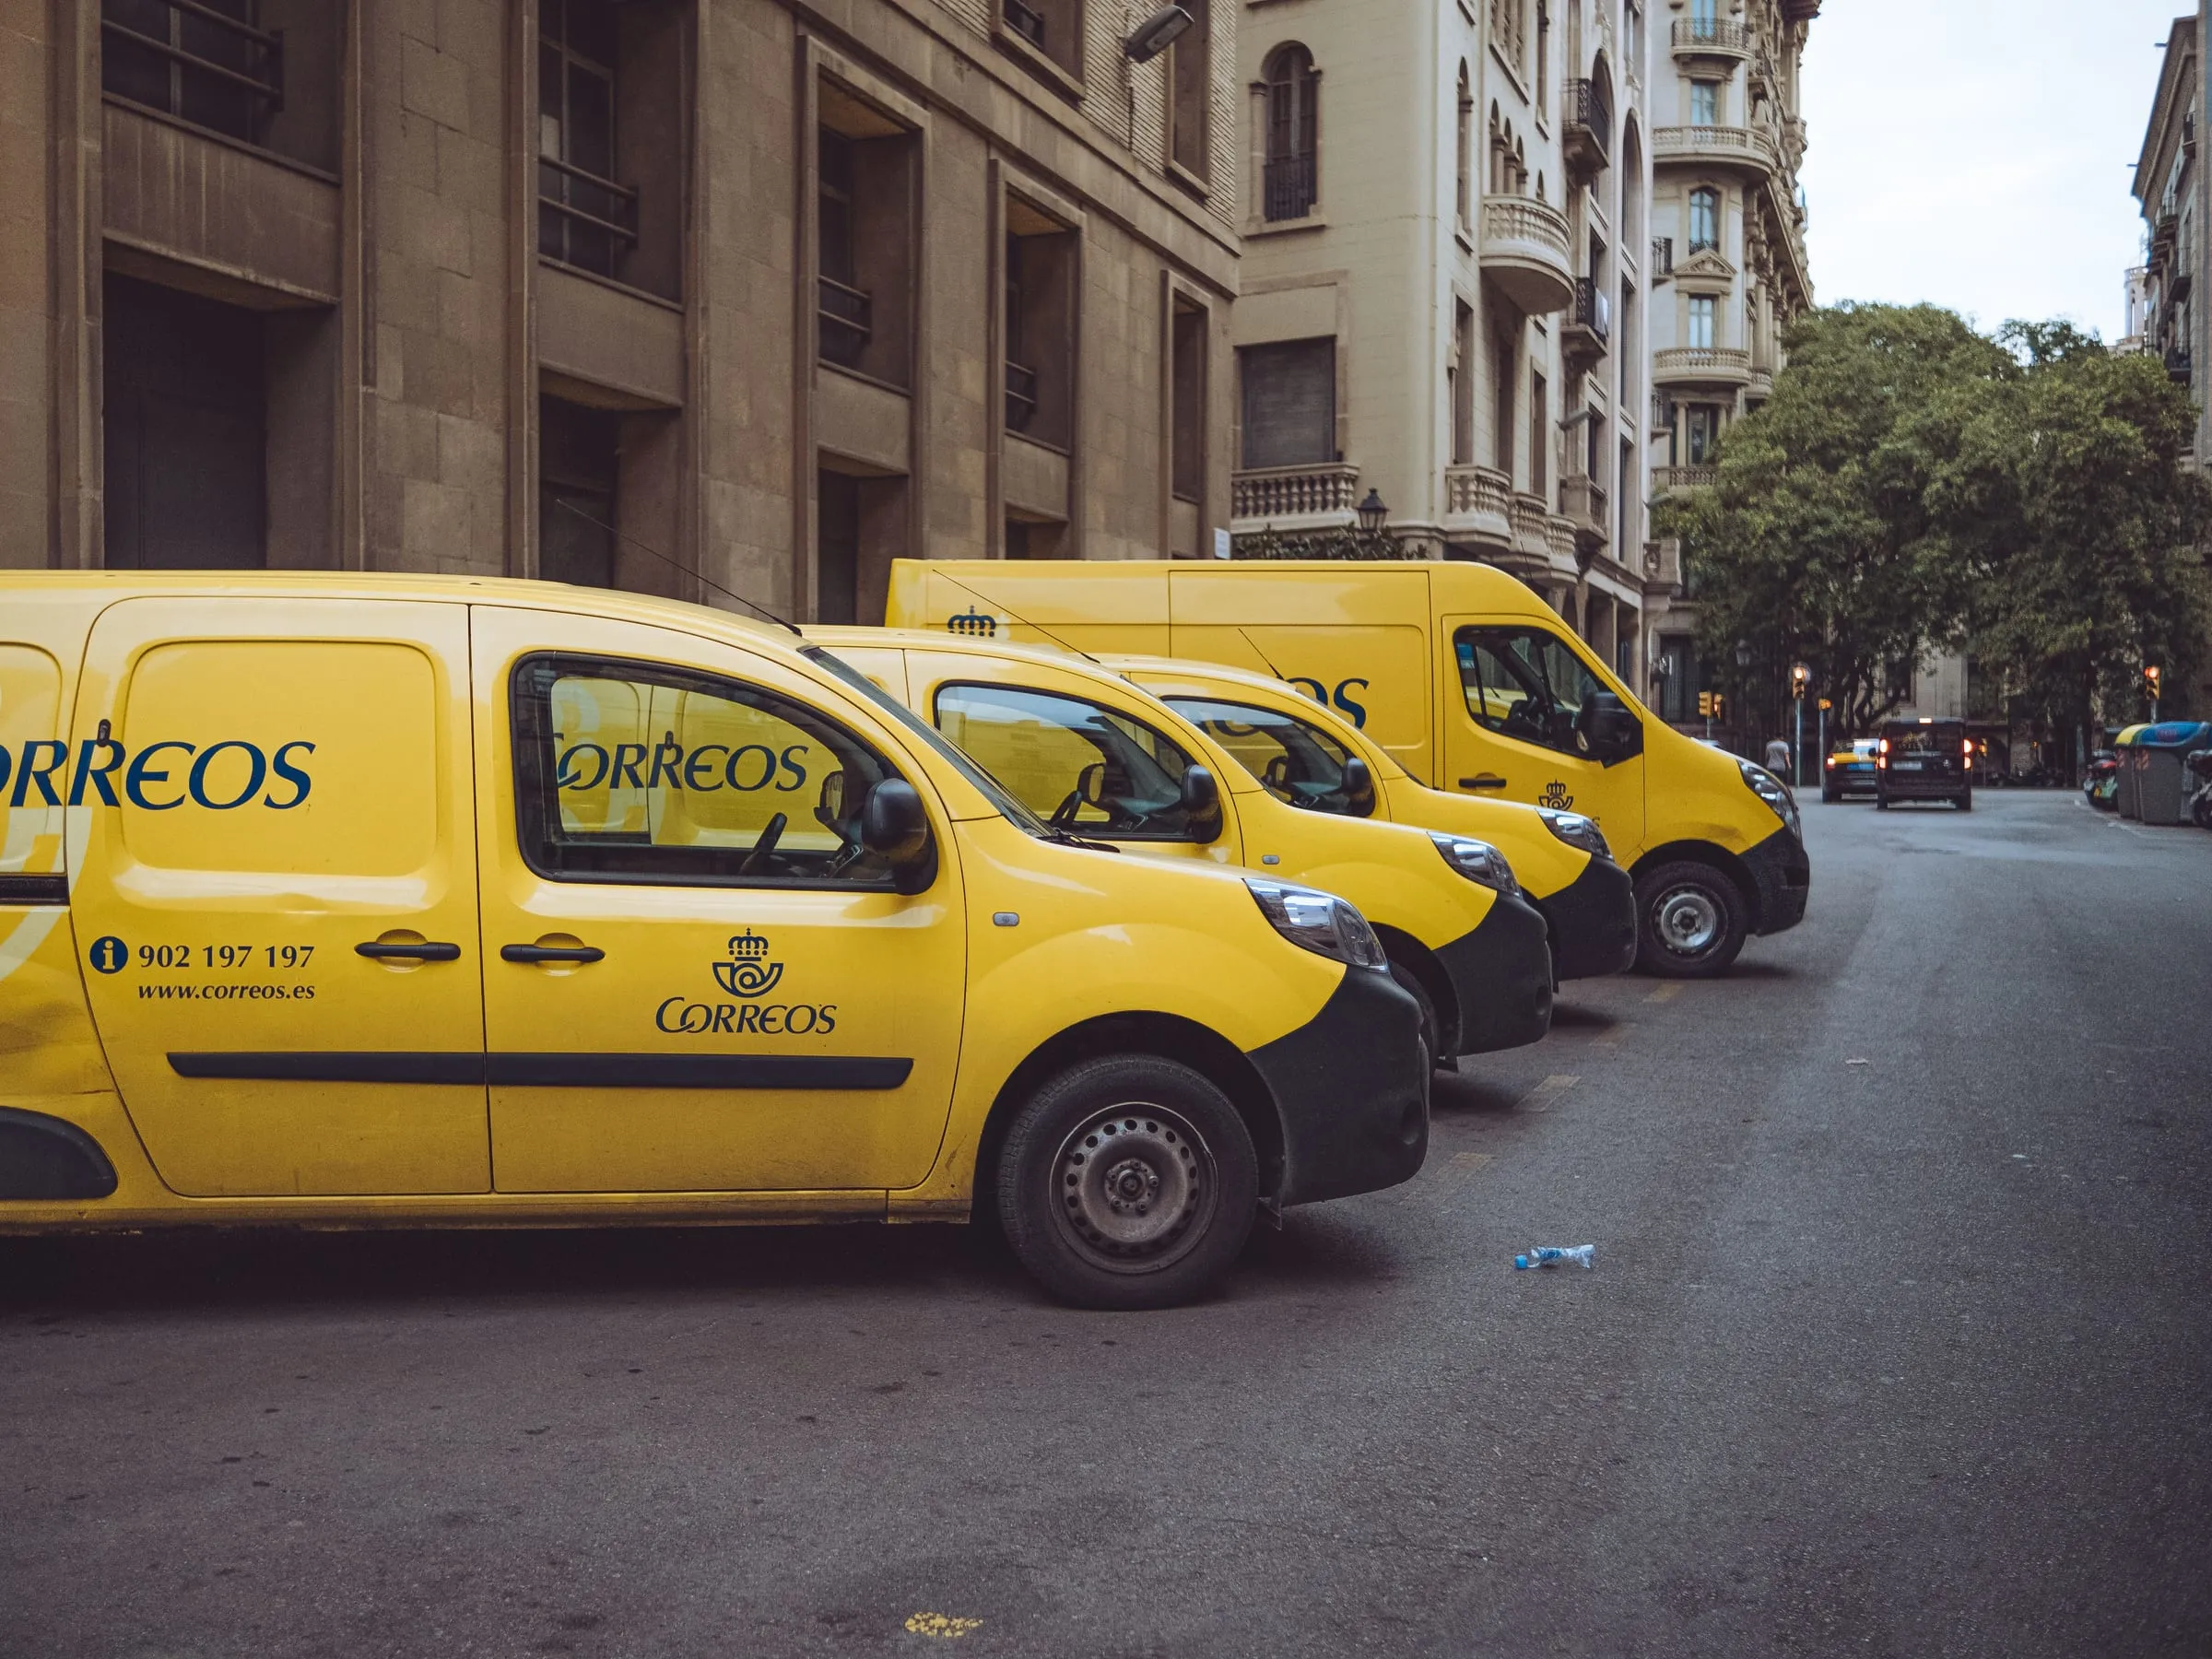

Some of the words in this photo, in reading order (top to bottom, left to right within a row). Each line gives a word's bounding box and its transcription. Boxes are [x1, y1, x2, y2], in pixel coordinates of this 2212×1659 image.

[0, 740, 316, 810] RREOS
[553, 733, 809, 792] ORREOS
[138, 945, 190, 968] 902
[202, 945, 253, 968] 197
[265, 945, 315, 968] 197
[138, 984, 315, 1000] www.correos.es
[655, 996, 838, 1034] CORREOS
